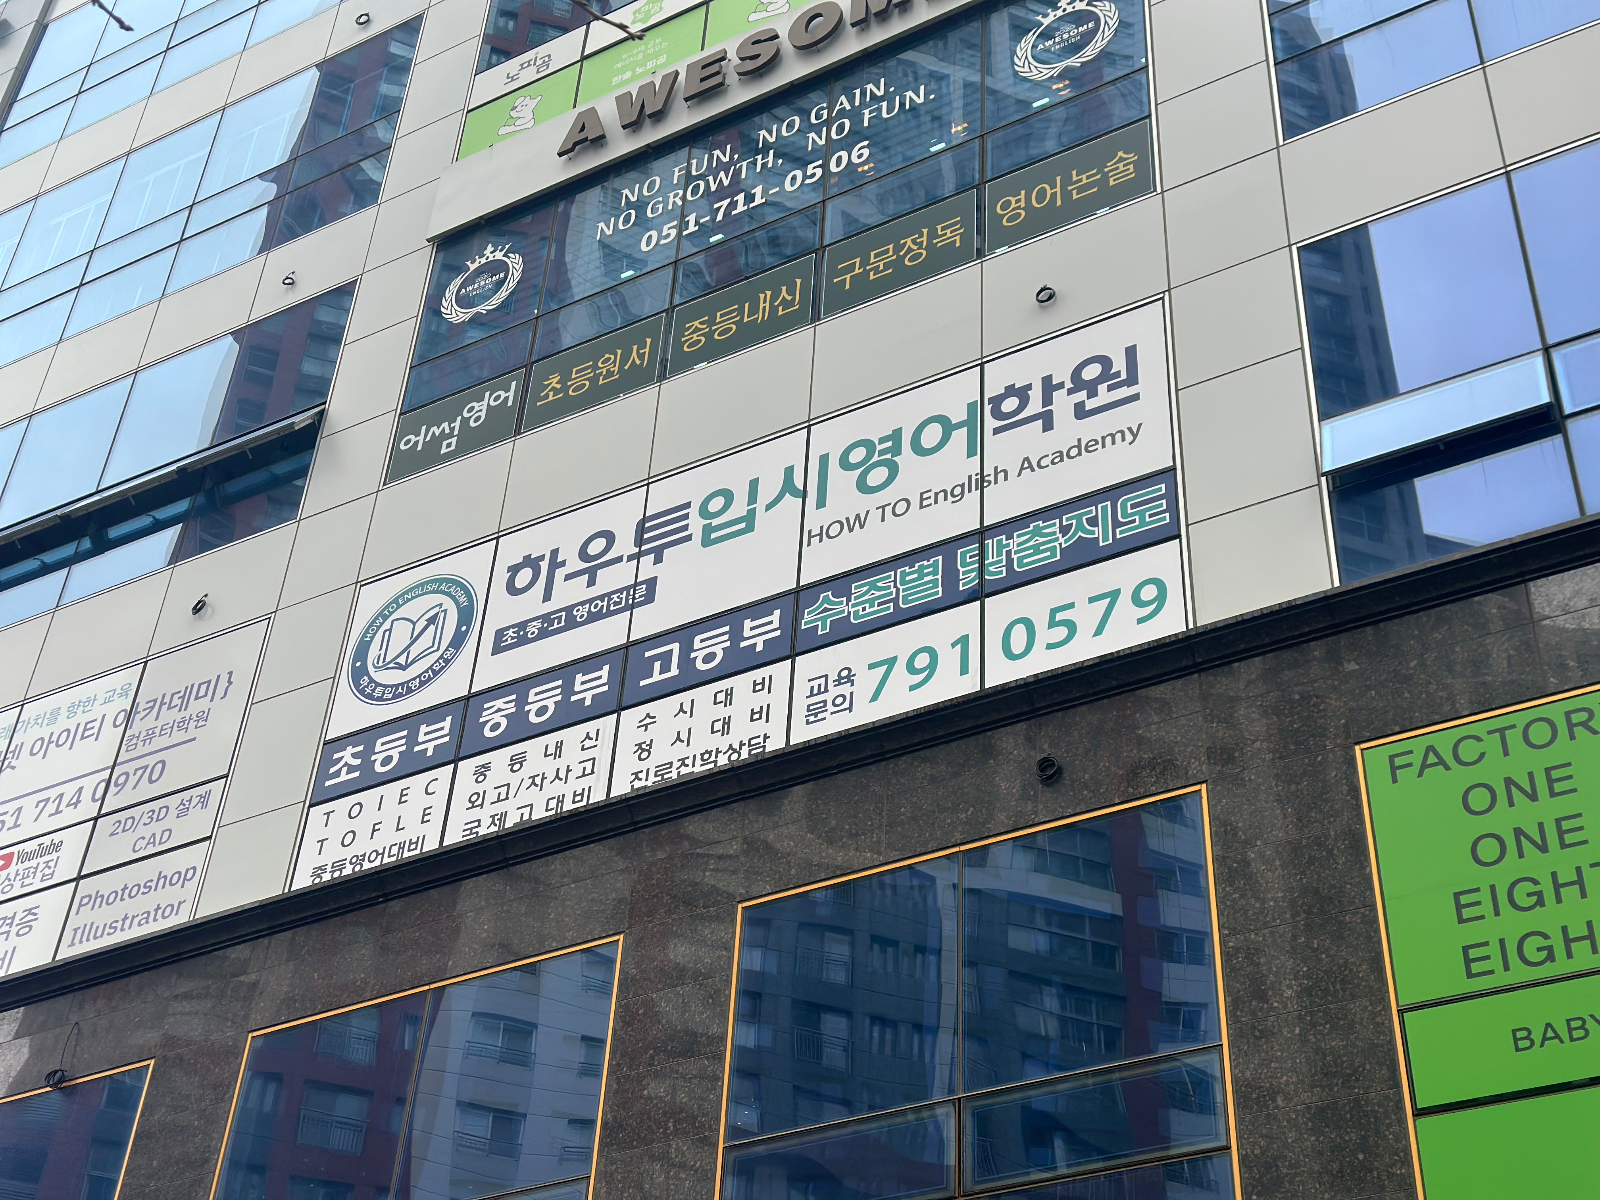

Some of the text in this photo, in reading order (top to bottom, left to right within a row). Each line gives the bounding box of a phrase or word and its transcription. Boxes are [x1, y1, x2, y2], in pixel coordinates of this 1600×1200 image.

[1037, 21, 1096, 51] AWESOME
[504, 52, 552, 86] 노피곰
[596, 84, 935, 240] NO GROWTH, NO FUN.
[620, 77, 895, 207] NO FUN, NO GAIN.
[640, 140, 870, 252] 051-711-0506
[996, 150, 1139, 227] 영어논술
[832, 217, 965, 290] 구문정독
[460, 271, 505, 294] AWESOME
[681, 278, 802, 353] 중등내신
[537, 337, 652, 407] 초등원서
[399, 381, 516, 454] 어썸영어
[807, 422, 1143, 548] HOW TO English Academy
[801, 483, 1170, 636] 수준별 맞춤지도
[363, 582, 469, 641] HOW TO ENGLISH ACADEMY
[573, 583, 647, 622] 영어전문
[639, 609, 781, 687] 고등부
[867, 577, 1169, 704] 791 0579
[15, 706, 61, 735] 가치를
[66, 694, 98, 719] 향한
[100, 682, 132, 706] 교육
[478, 664, 610, 738] 중등부
[804, 691, 854, 726] 문의
[805, 666, 856, 699] 교육
[29, 713, 106, 760] 아이티
[124, 708, 211, 753] 컴퓨터학원
[324, 716, 452, 787] 초등부
[33, 785, 84, 823] 714
[91, 759, 167, 803] 0970
[466, 757, 596, 811] 외고/자사고
[1461, 761, 1578, 817] ONE
[108, 789, 212, 837] 2D/3D 설계
[132, 828, 172, 854] CAD
[1470, 812, 1589, 868] ONE
[15, 839, 63, 866] YouTube
[310, 834, 426, 885] 중등영어대비
[75, 865, 197, 916] Photoshop
[67, 899, 187, 948] Illustrator
